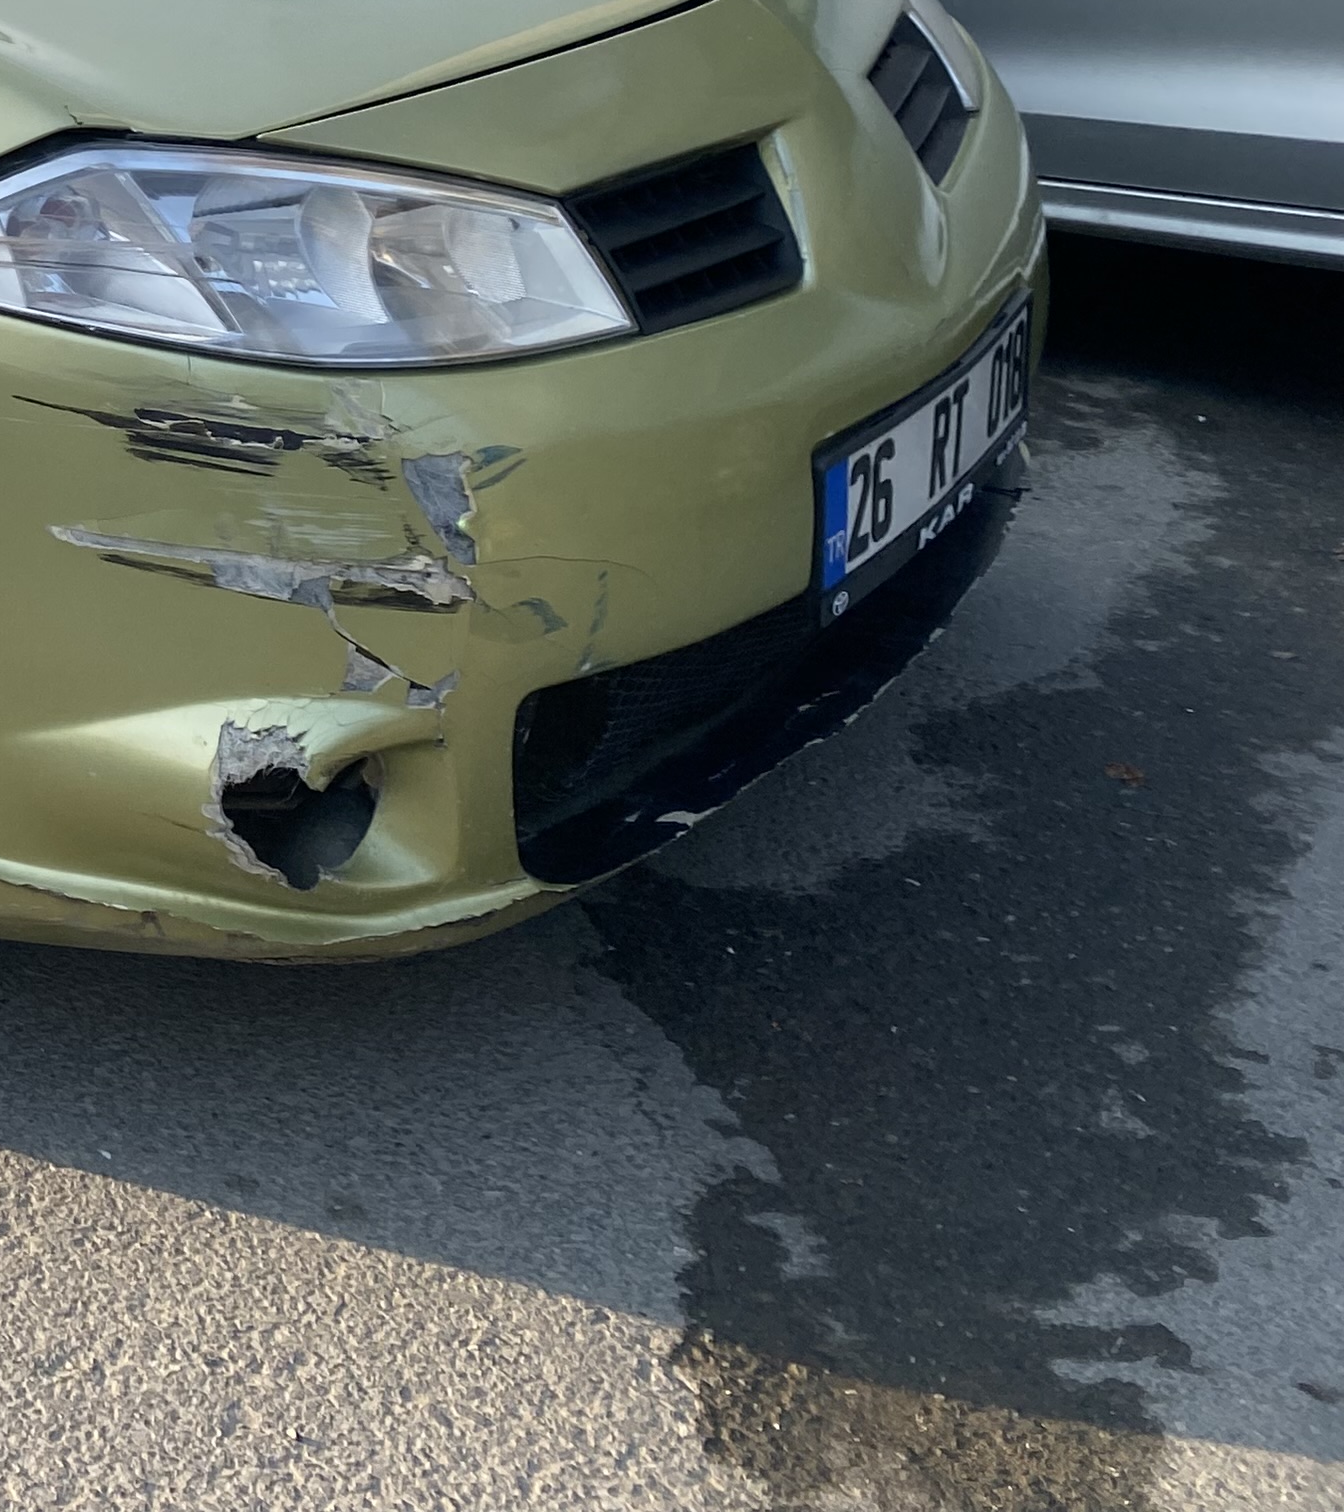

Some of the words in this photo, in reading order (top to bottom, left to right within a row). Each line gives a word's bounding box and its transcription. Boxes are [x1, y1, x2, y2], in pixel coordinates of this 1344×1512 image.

[846, 437, 897, 564] 26
[927, 377, 970, 500] RT
[986, 319, 1026, 439] 018
[826, 529, 846, 564] TR
[917, 482, 976, 551] KAR
